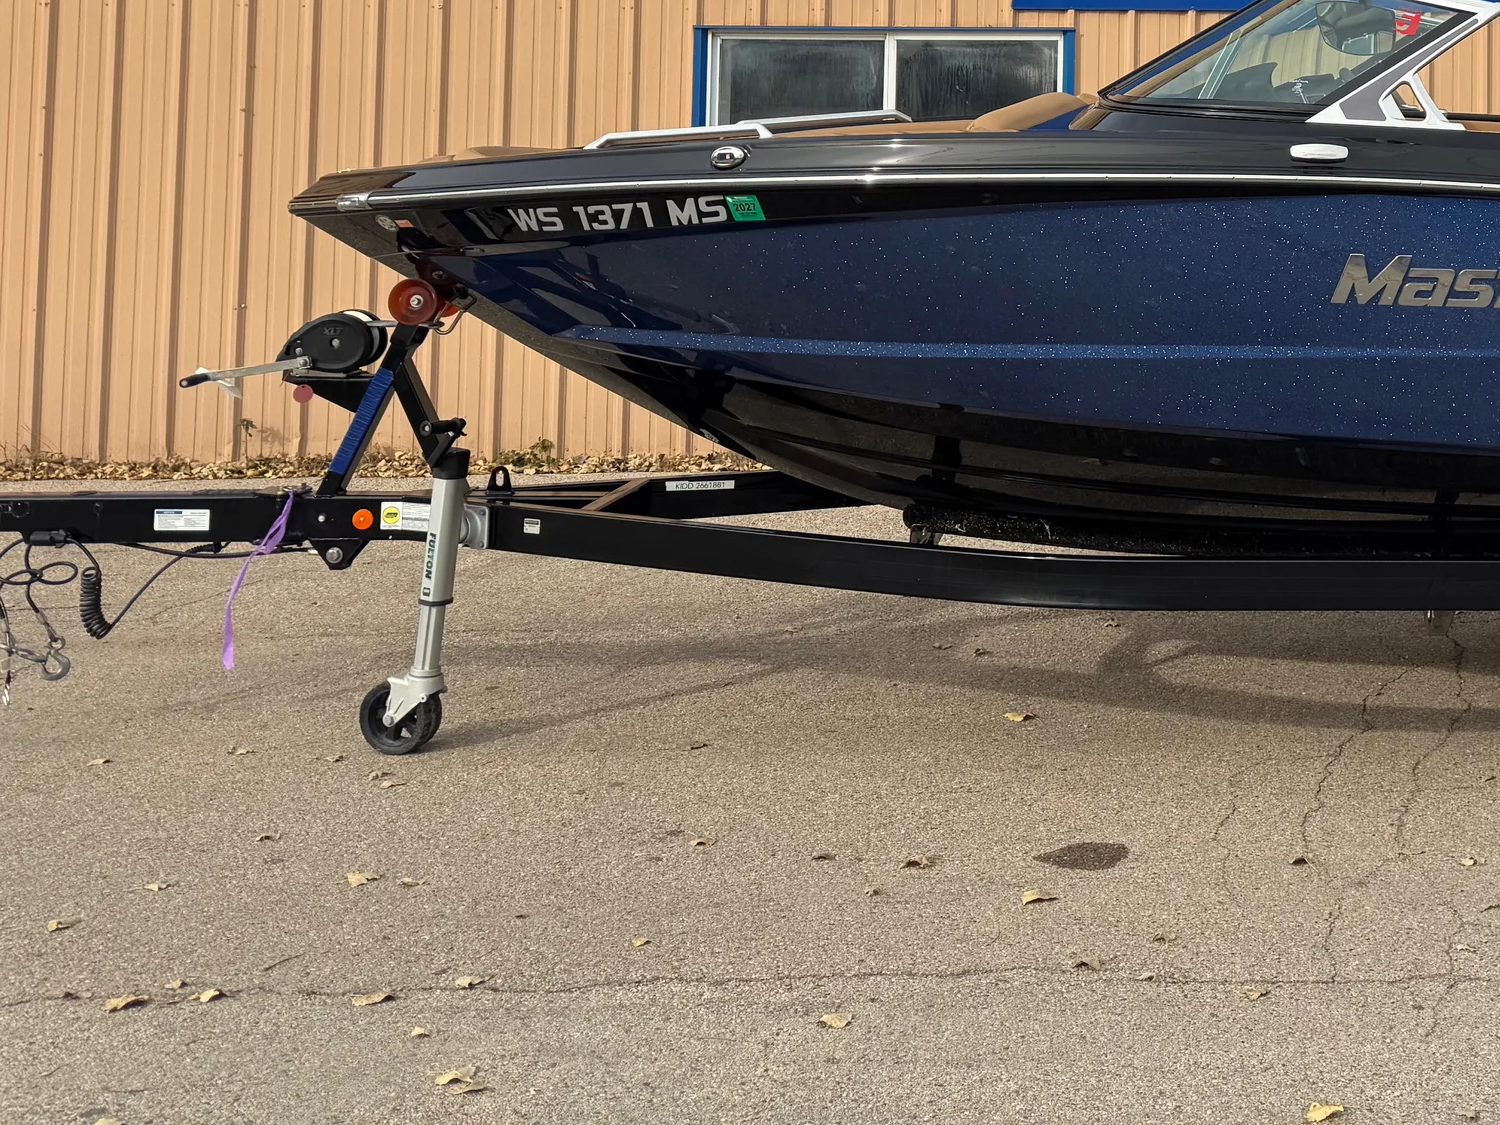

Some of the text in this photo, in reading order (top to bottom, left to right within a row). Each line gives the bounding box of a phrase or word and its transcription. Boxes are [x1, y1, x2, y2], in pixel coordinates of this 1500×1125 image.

[507, 194, 728, 232] WS 1371 MS
[732, 202, 756, 212] 2027
[675, 482, 694, 490] KIDD
[425, 532, 437, 581] FULTON
